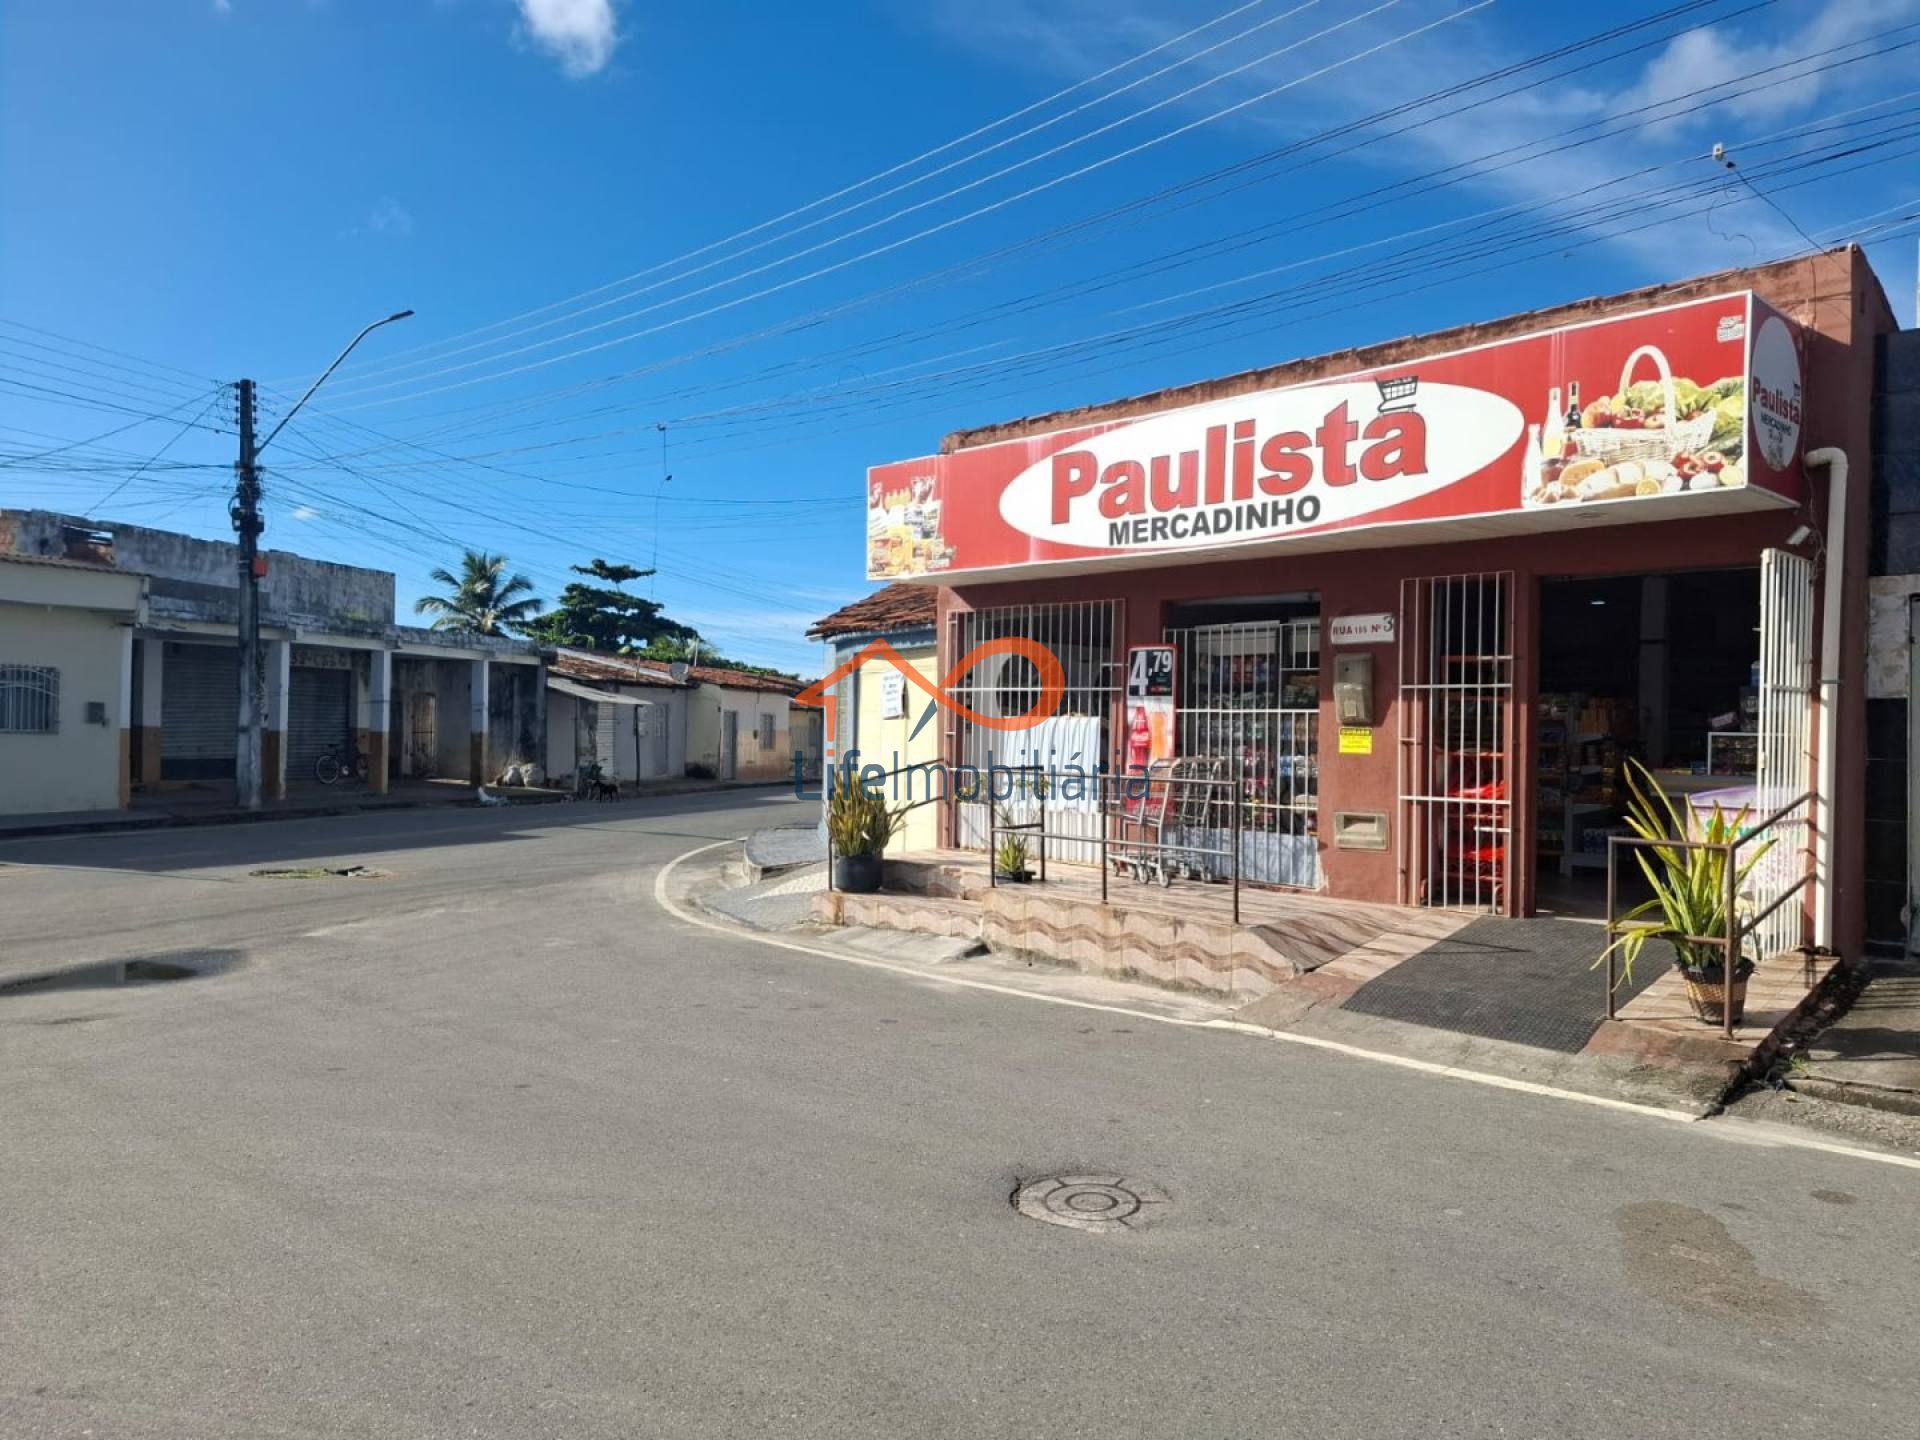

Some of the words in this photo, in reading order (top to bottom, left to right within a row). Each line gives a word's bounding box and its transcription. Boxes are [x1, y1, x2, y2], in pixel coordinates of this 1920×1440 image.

[1753, 376, 1800, 424] Paulista
[1051, 400, 1428, 525] Paulista
[1109, 495, 1321, 546] MERCADINHO
[1332, 625, 1353, 636] RUA
[1383, 615, 1393, 632] 3
